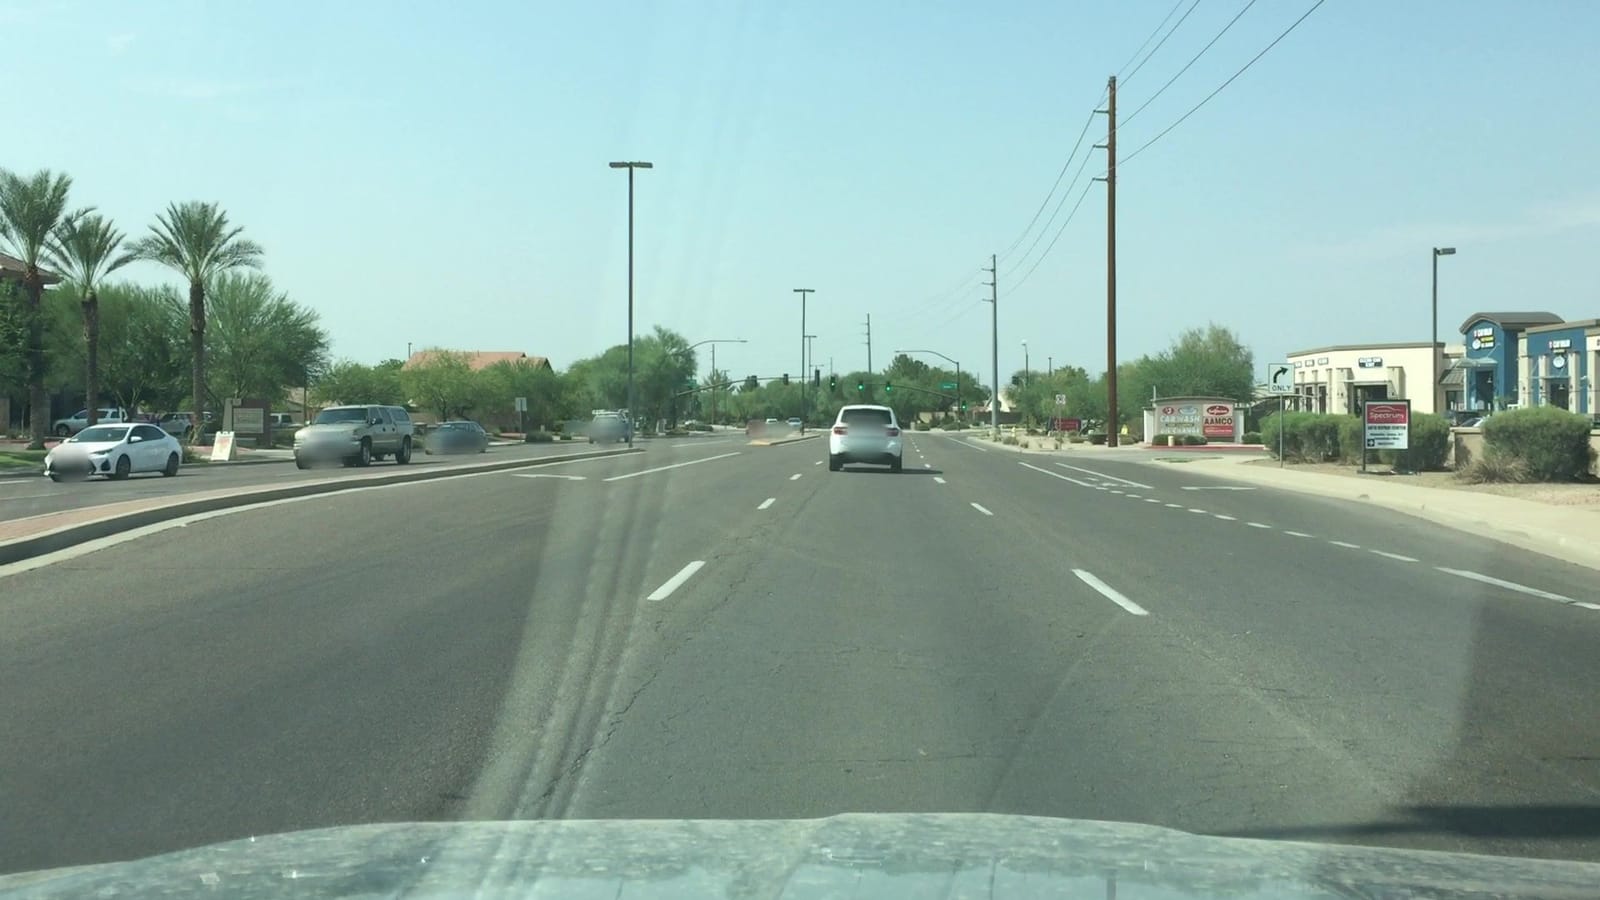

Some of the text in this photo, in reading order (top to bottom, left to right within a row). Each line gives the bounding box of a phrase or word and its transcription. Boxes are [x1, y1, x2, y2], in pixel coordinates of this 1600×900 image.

[1271, 384, 1292, 392] ONLY
[1369, 412, 1404, 421] Spectrum
[1204, 417, 1233, 425] AAMCO
